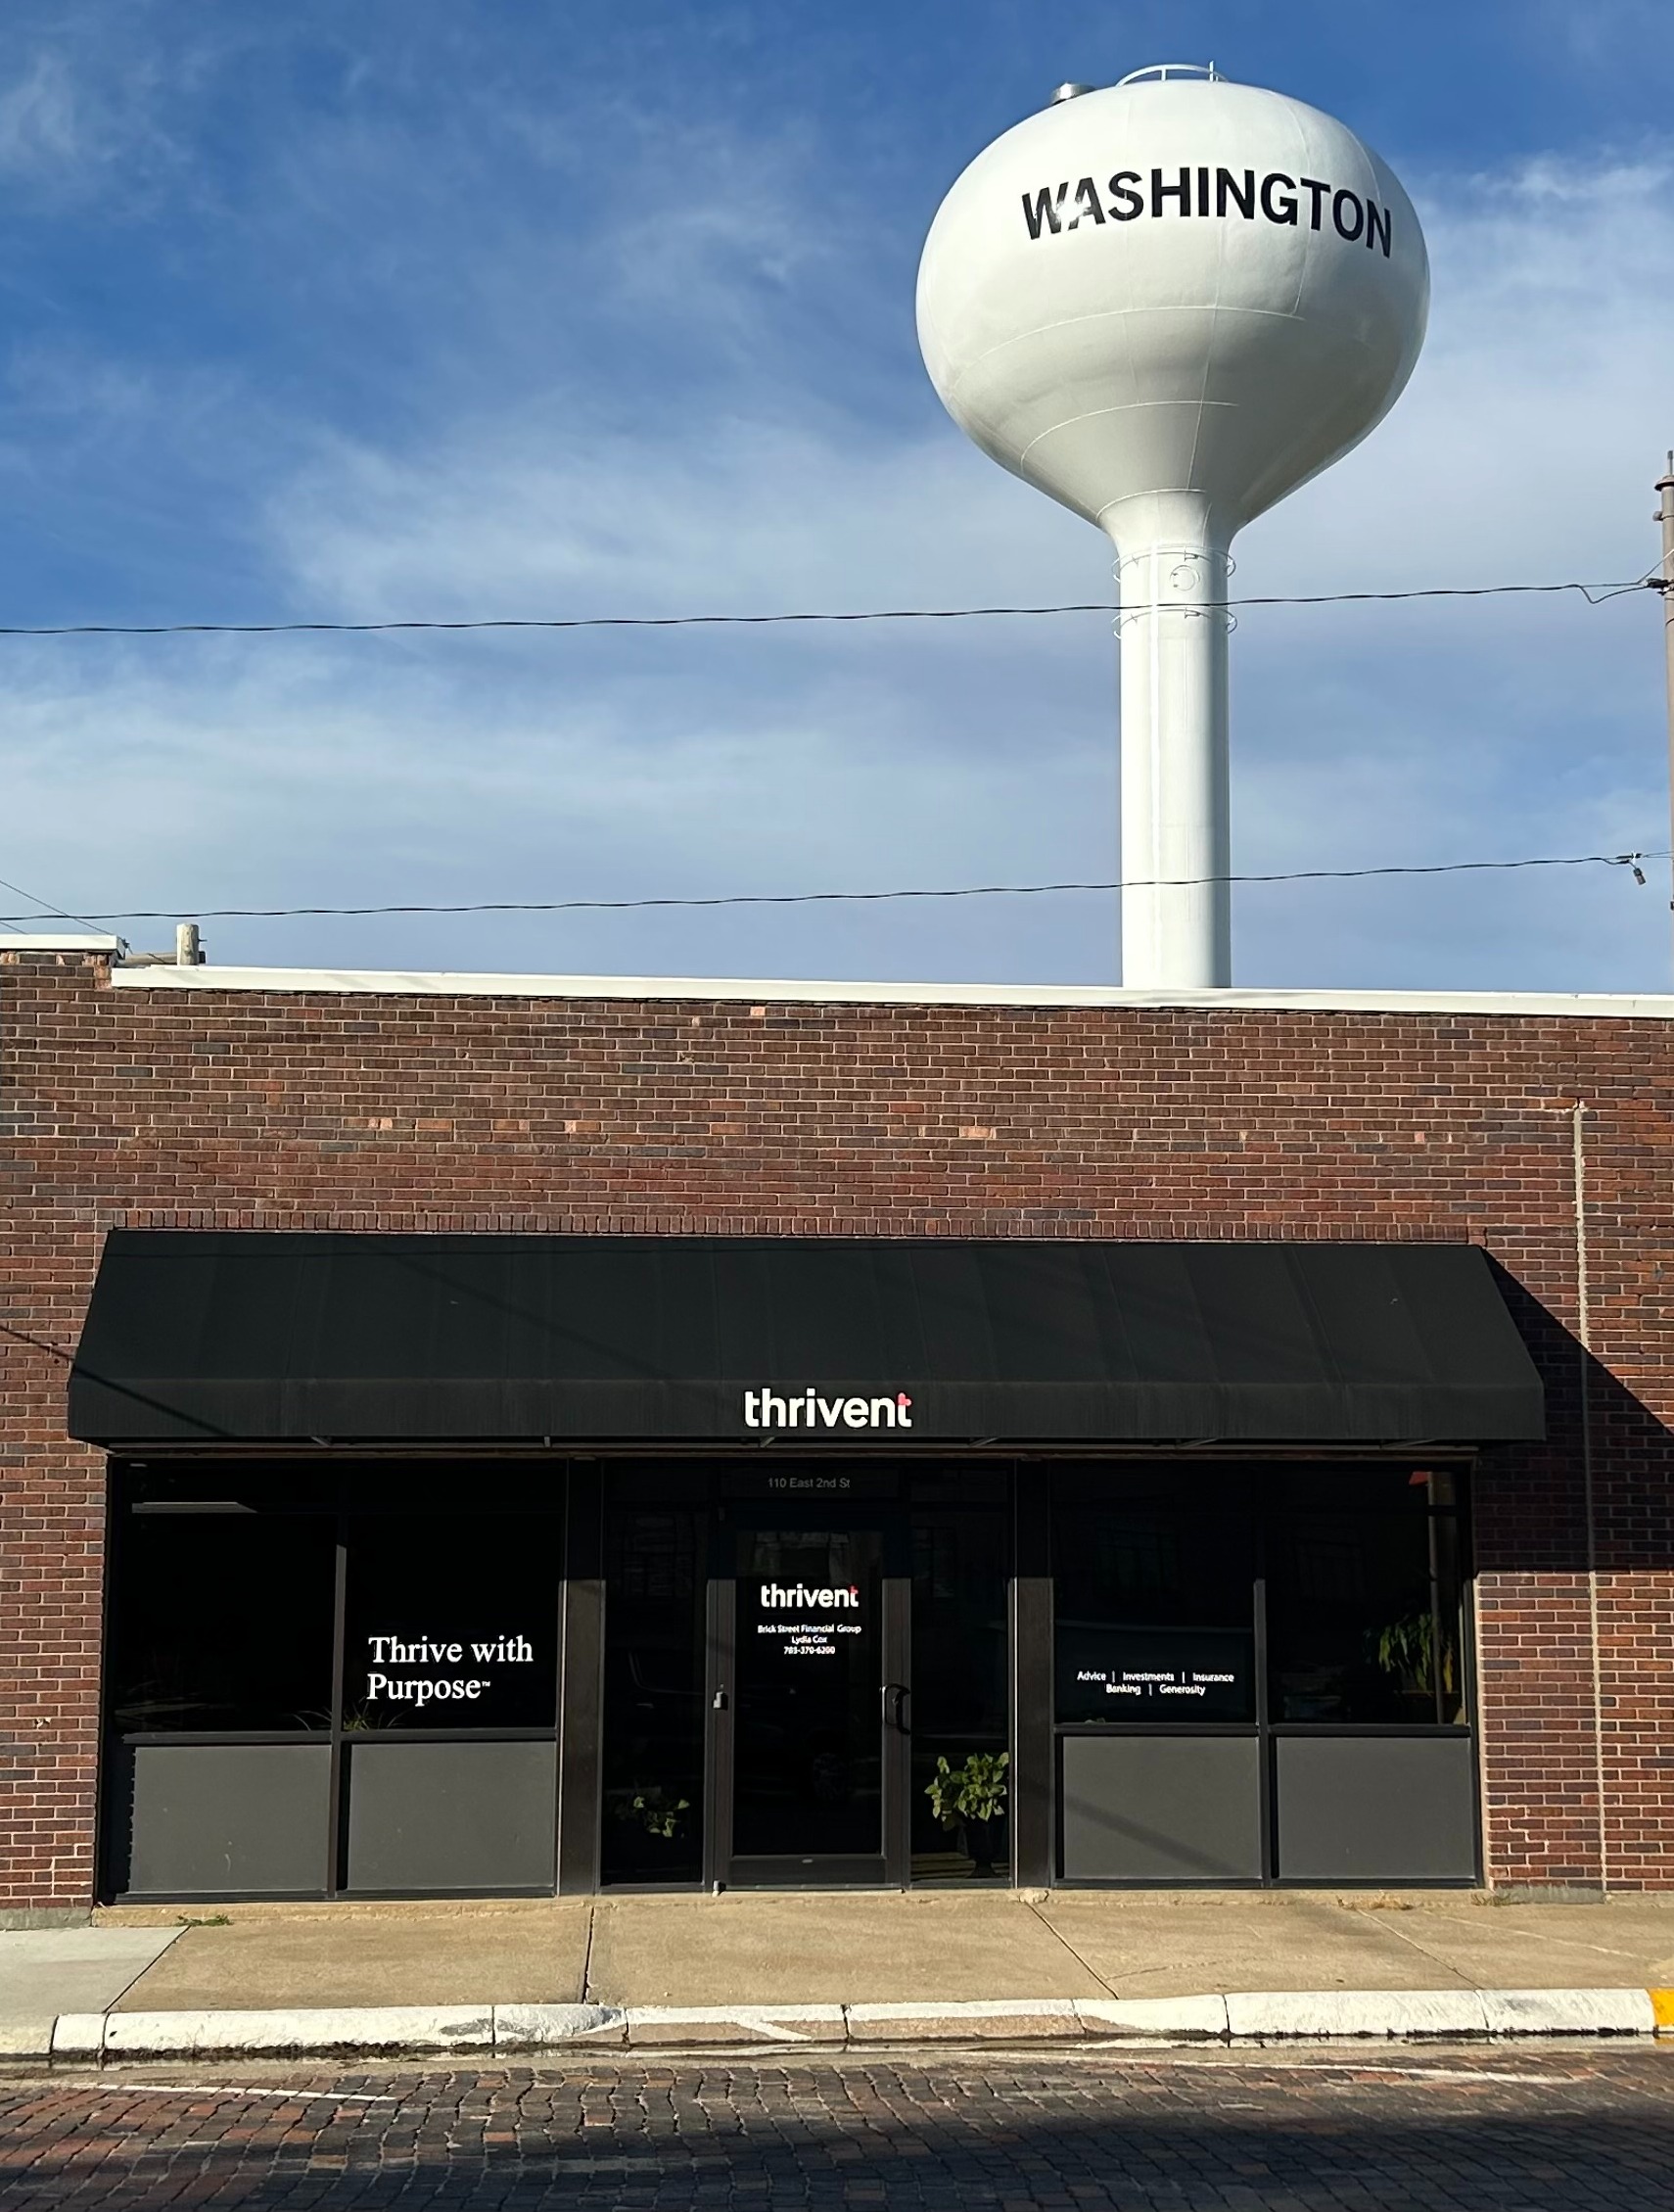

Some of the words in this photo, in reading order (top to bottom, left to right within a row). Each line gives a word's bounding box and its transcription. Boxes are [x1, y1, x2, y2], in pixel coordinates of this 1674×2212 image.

[1021, 166, 1392, 259] WASHINGTON
[744, 1387, 913, 1429] thrivent
[767, 1478, 787, 1488] 110
[789, 1478, 814, 1488] East
[816, 1478, 836, 1488] 2nd
[839, 1478, 851, 1488] St
[761, 1583, 860, 1608] thrivent
[757, 1624, 777, 1633] Brick
[777, 1624, 800, 1633] Street
[801, 1624, 835, 1633] Financial
[837, 1624, 862, 1634] Group
[791, 1635, 812, 1645] Lydia
[813, 1634, 828, 1644] Cox
[368, 1635, 463, 1663] Thrive
[471, 1634, 534, 1662] with
[1077, 1671, 1106, 1681] Advice
[1123, 1671, 1175, 1682] Investments
[1192, 1672, 1235, 1682] Insurance
[1105, 1683, 1141, 1696] Banking
[1159, 1683, 1206, 1696] Generosity
